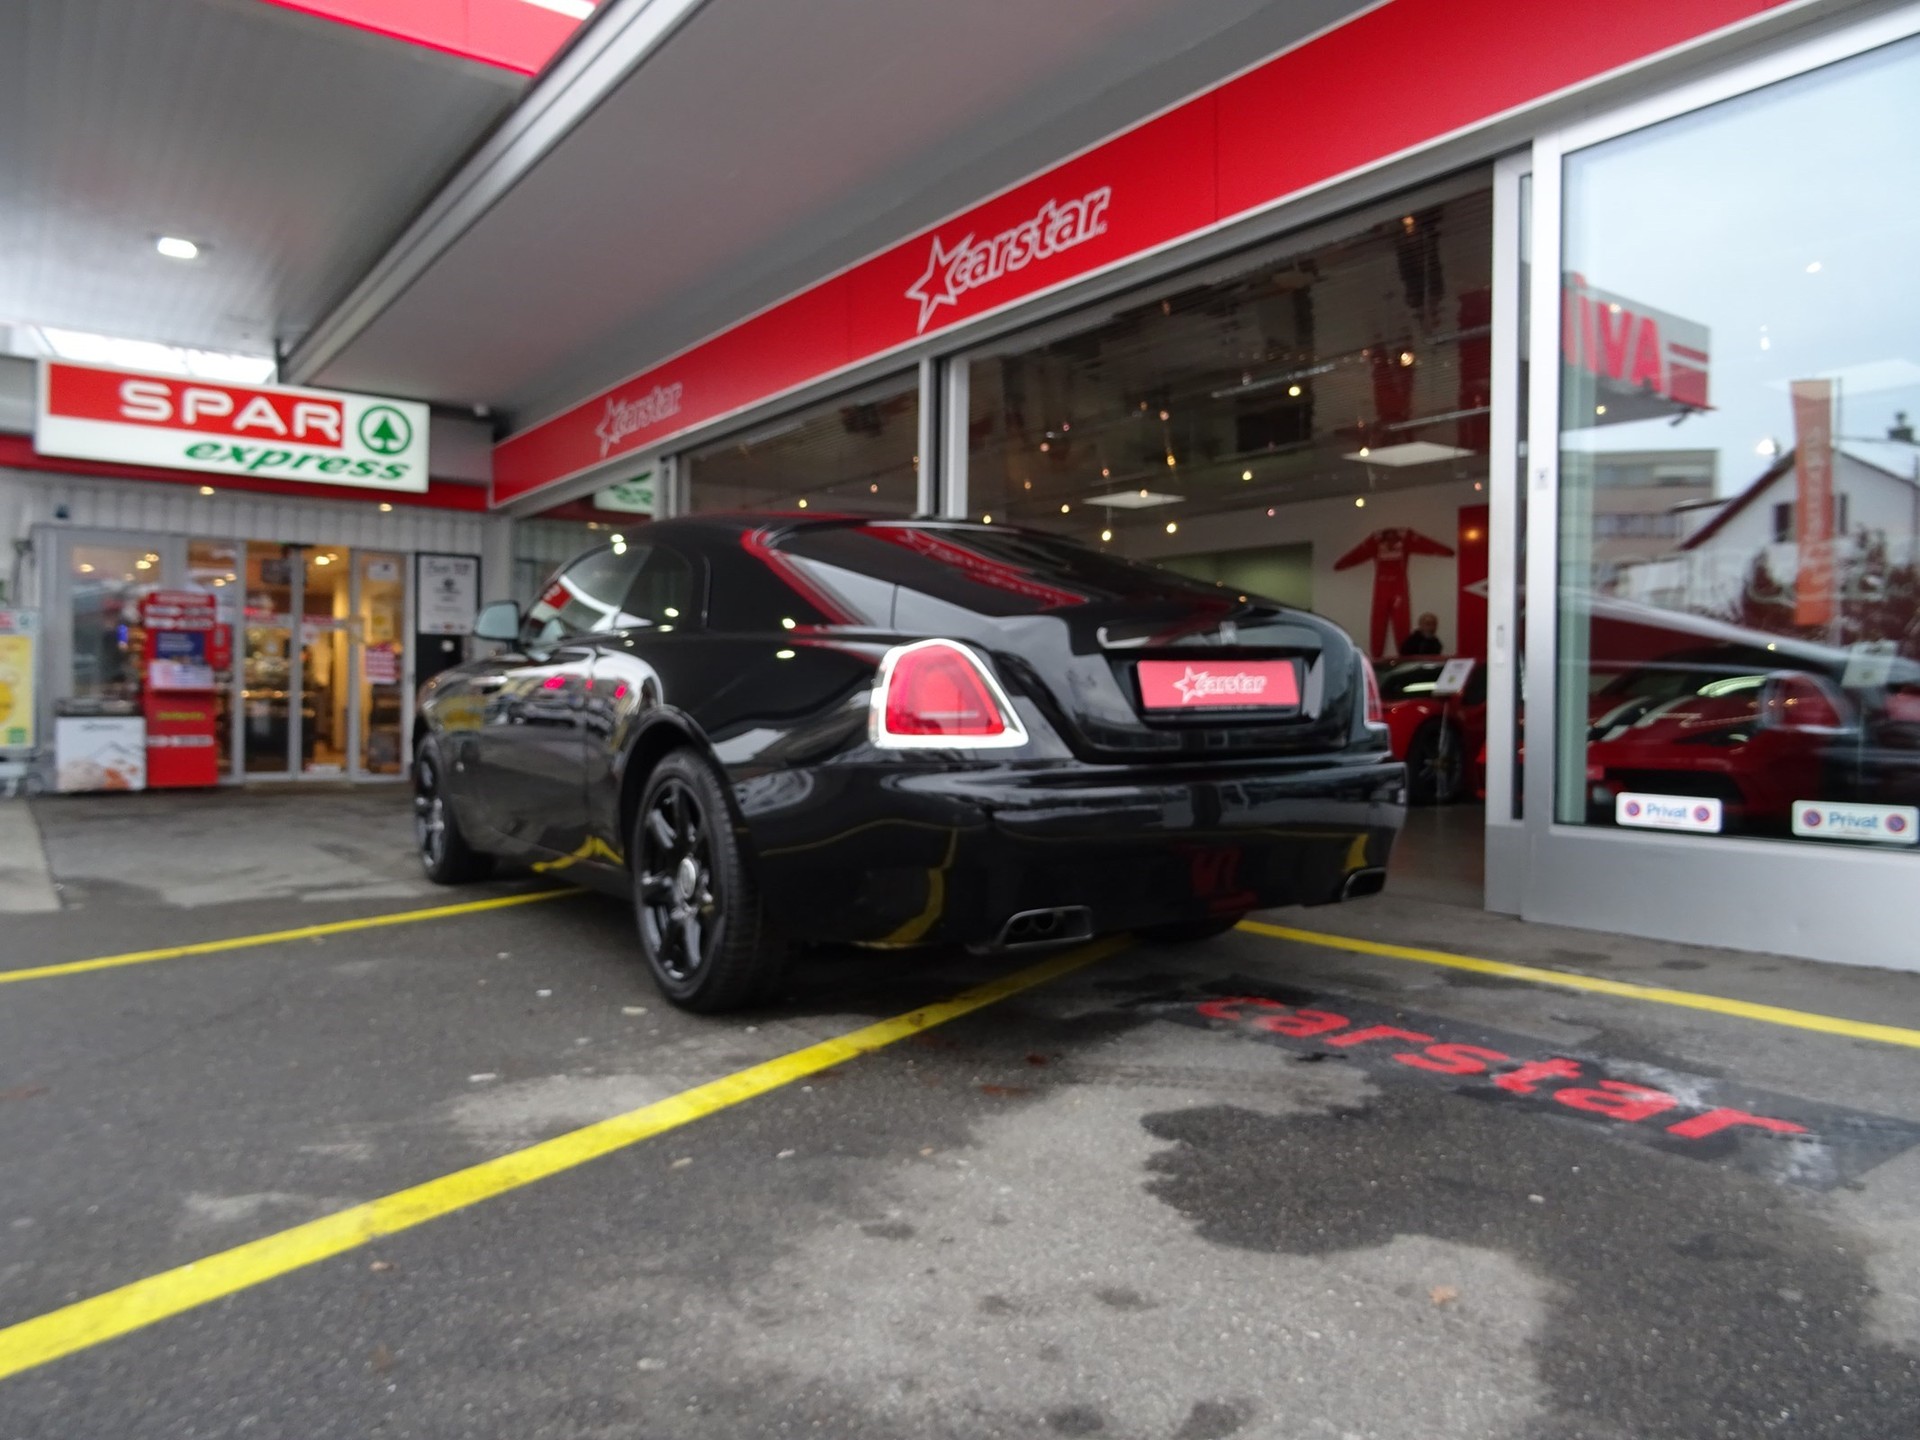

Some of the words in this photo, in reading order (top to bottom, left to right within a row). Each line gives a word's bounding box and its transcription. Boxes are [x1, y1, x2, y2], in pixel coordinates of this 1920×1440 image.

[948, 186, 1111, 295] carstar
[119, 380, 341, 442] SPAR
[611, 382, 682, 439] carstar
[184, 442, 411, 481] express
[1196, 672, 1268, 694] carstar
[1646, 802, 1687, 819] Privat
[1828, 811, 1878, 829] Privat
[1197, 995, 1808, 1138] carstar
